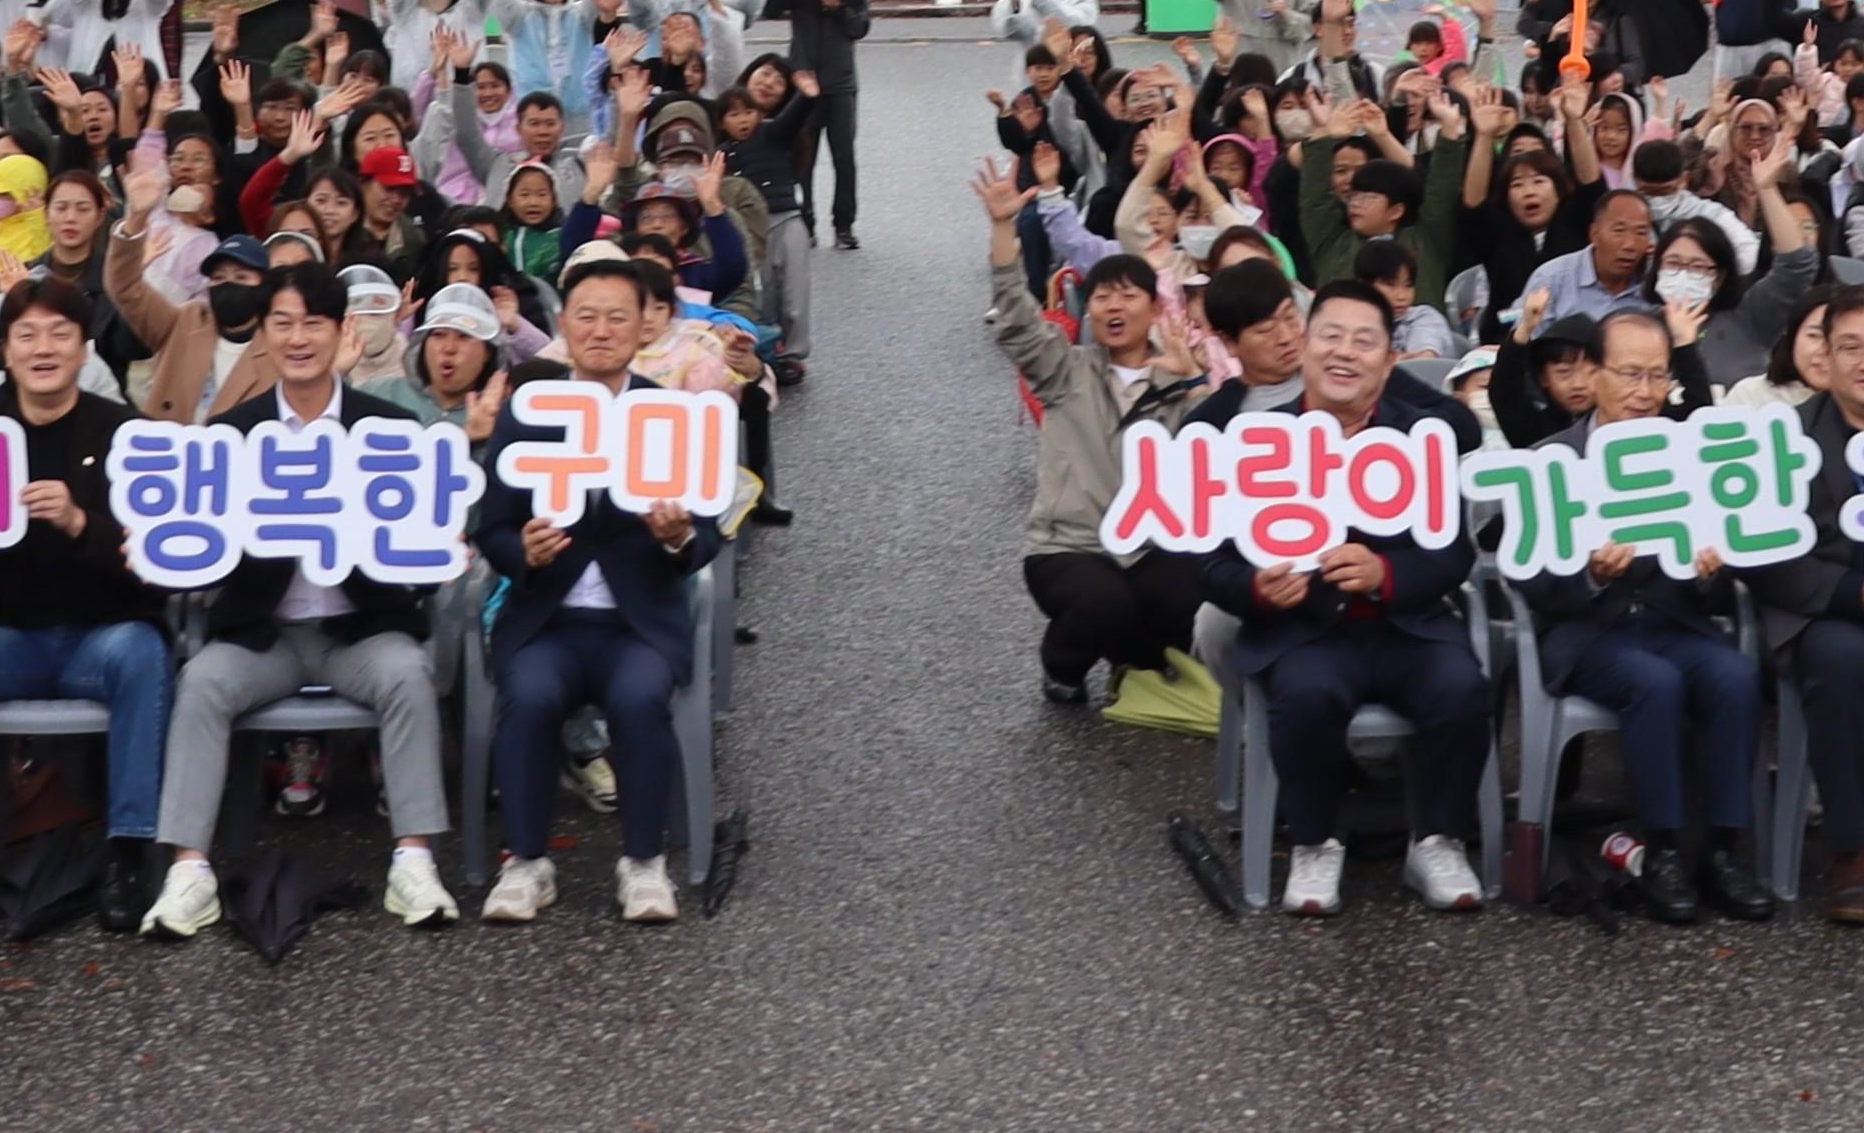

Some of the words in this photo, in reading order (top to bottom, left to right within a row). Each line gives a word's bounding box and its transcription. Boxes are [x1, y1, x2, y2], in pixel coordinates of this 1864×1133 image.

[122, 433, 468, 571] 행복한
[514, 393, 718, 513] 구미
[1115, 425, 1444, 558] 사랑이
[1473, 418, 1806, 566] 가득한
